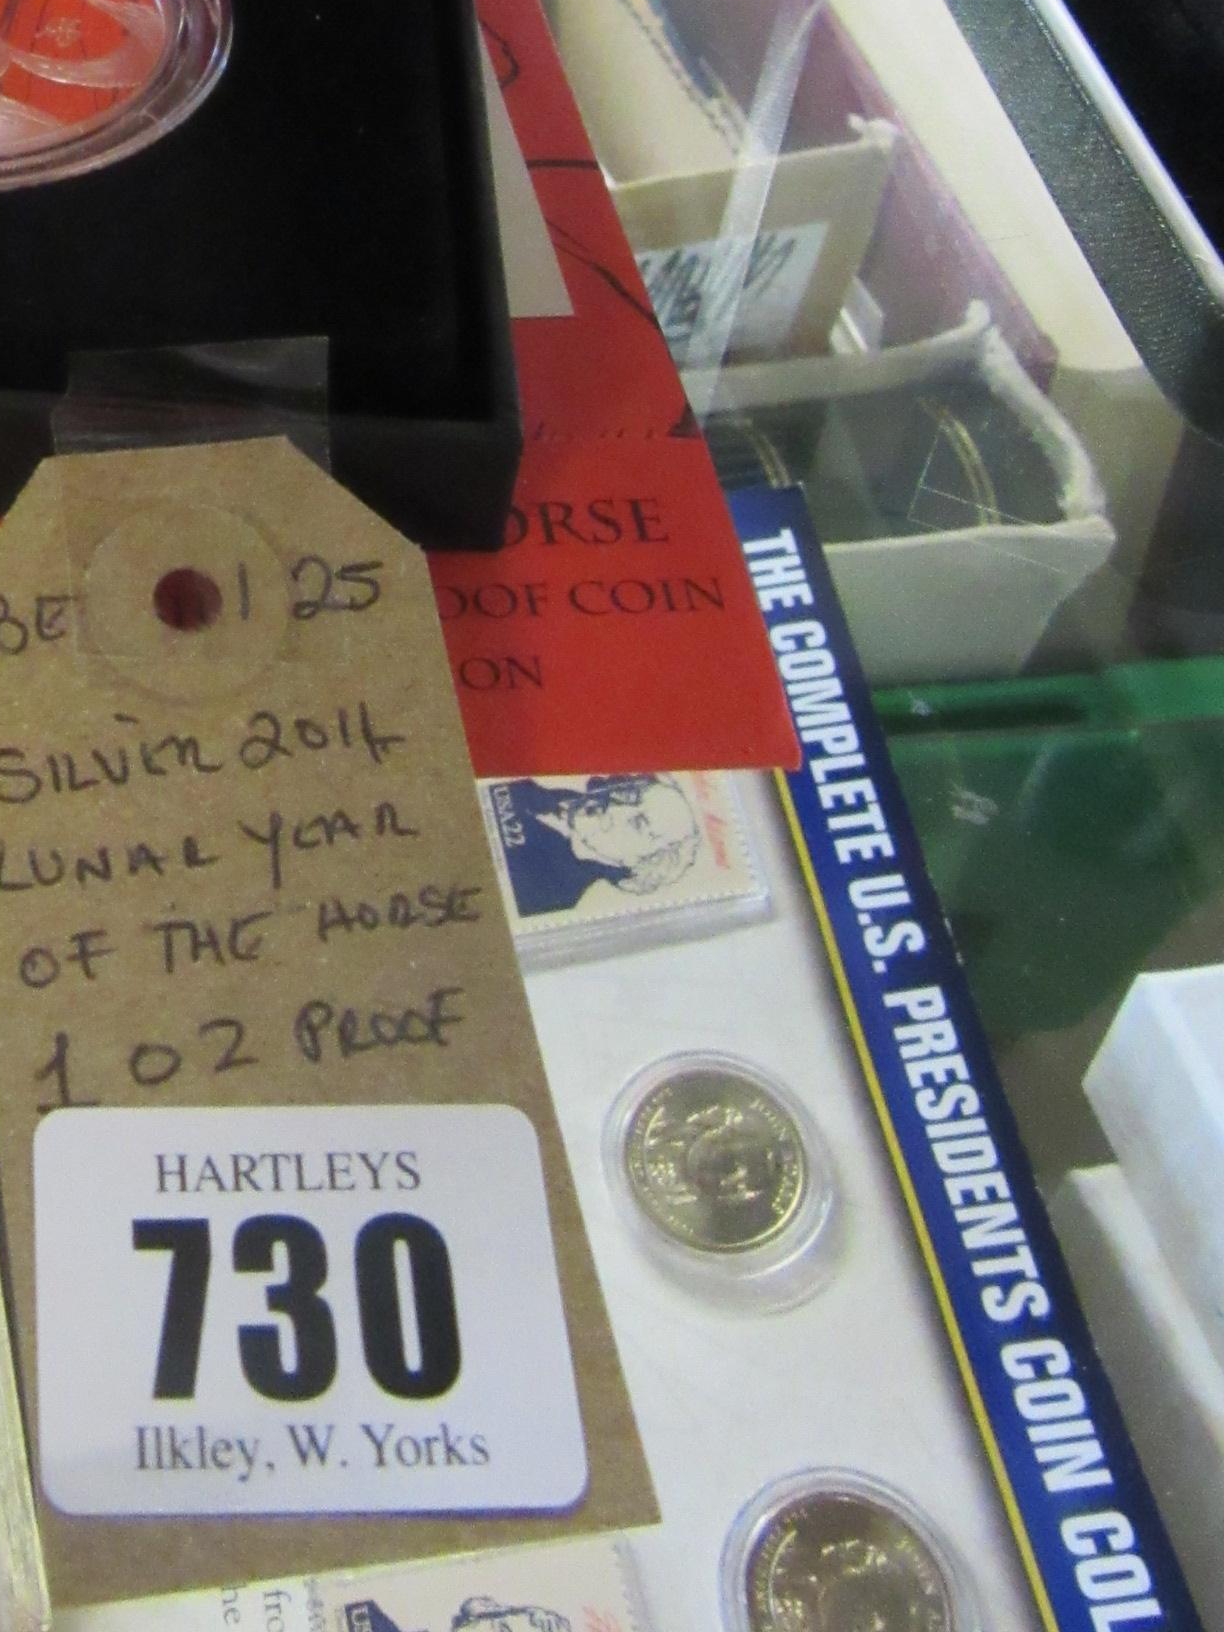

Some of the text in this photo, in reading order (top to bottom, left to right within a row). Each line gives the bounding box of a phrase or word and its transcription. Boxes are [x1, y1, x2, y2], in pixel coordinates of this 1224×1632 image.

[567, 576, 726, 617] COIN
[239, 701, 406, 769] 2014
[237, 801, 420, 890] YEAR
[19, 886, 482, 989] OF THE HORSE
[294, 986, 466, 1065] PROOF
[742, 527, 1168, 1632] THE COMPLETE U.S. PRESIDENTS COIN COL
[153, 1150, 423, 1194] HARTLEYS
[131, 1211, 462, 1403] 730
[134, 1422, 492, 1483] Ilkley, W. Yorks
